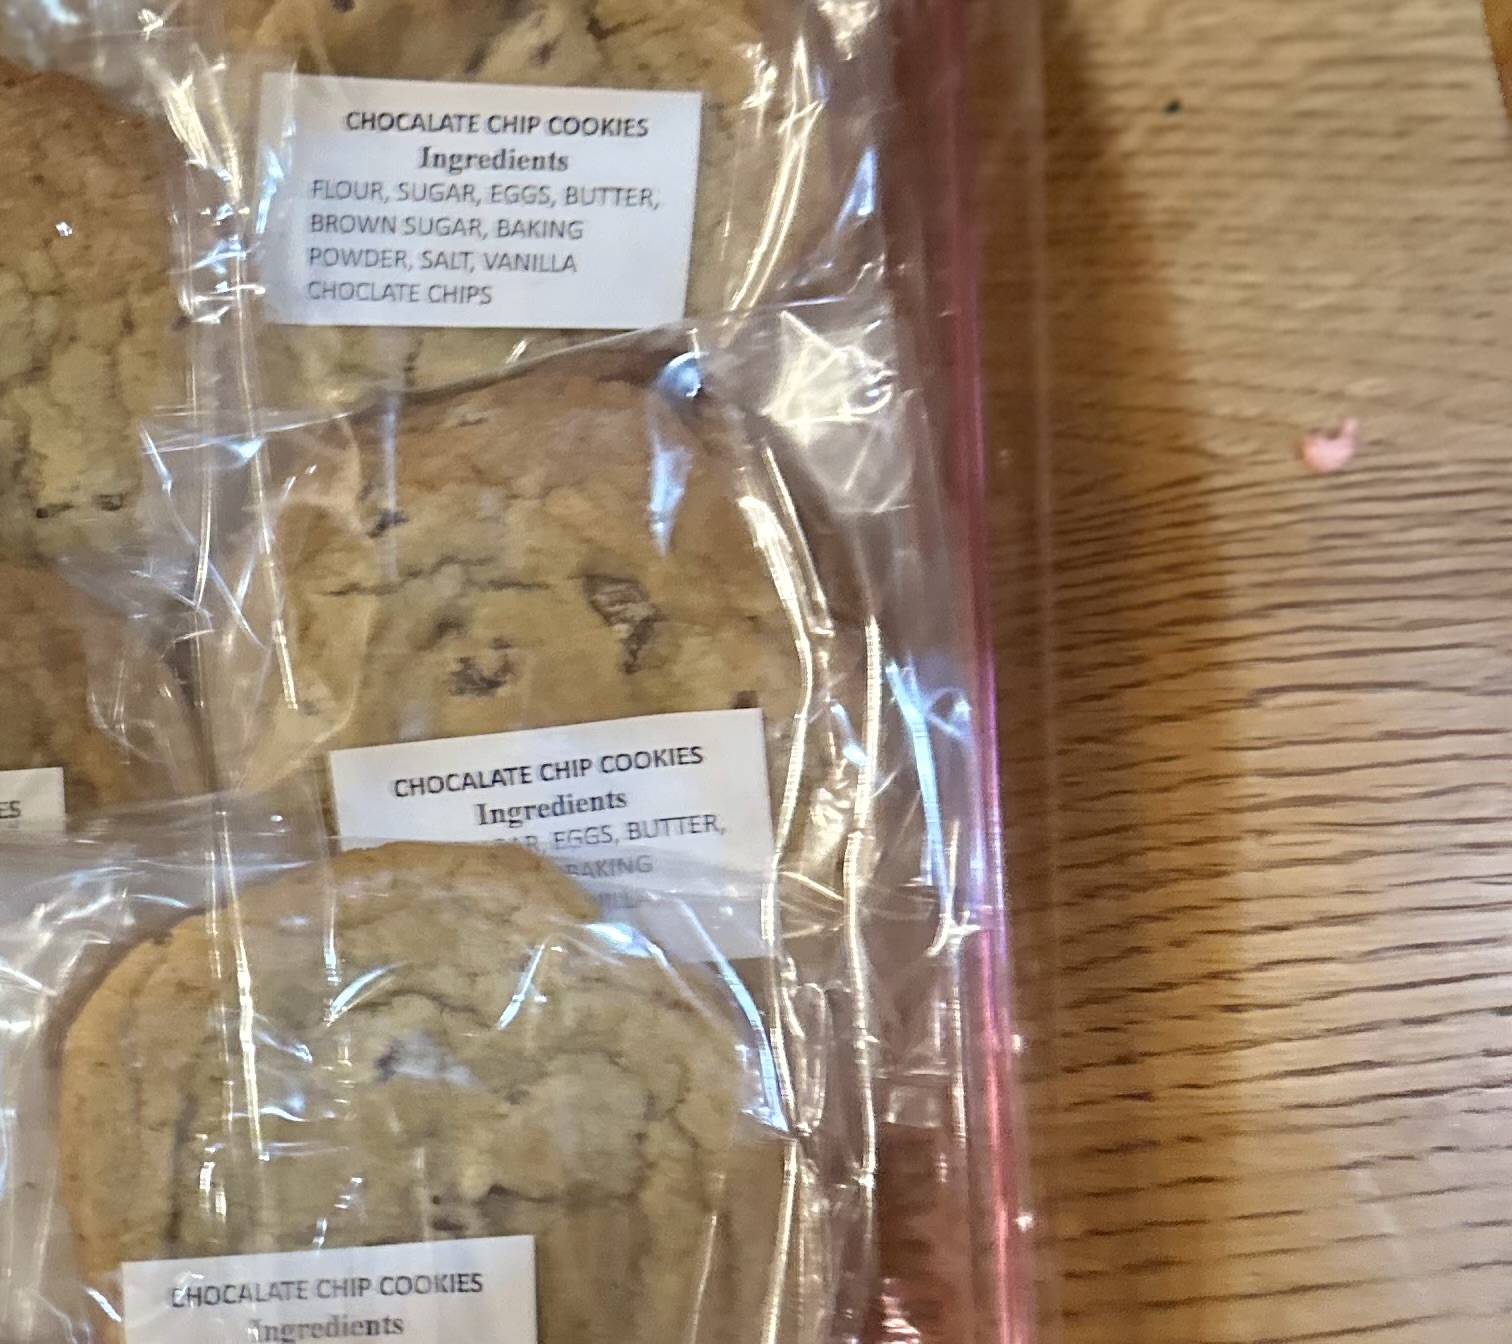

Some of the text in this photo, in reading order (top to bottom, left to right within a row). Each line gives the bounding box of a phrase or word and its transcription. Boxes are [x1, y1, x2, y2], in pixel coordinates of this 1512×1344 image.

[345, 111, 649, 137] CHOCALATE CHIP COOKIES
[419, 146, 569, 174] Ingredients
[312, 179, 661, 211] FLOUR, SUGAR, EGGS, BUTTER,
[311, 214, 585, 241] BROWN SUGAR, BAKING
[307, 246, 577, 274] POWDER, SALT, VANILLA
[307, 281, 493, 305] CHOCLATE CHIPS
[393, 746, 704, 798] CHOCALATE CHIP COOKIES
[475, 791, 627, 828] Ingredients
[554, 824, 620, 851] EGGS,
[627, 814, 727, 841] BUTTER,
[170, 1272, 484, 1308] CHOCALATE CHIP COOKIES
